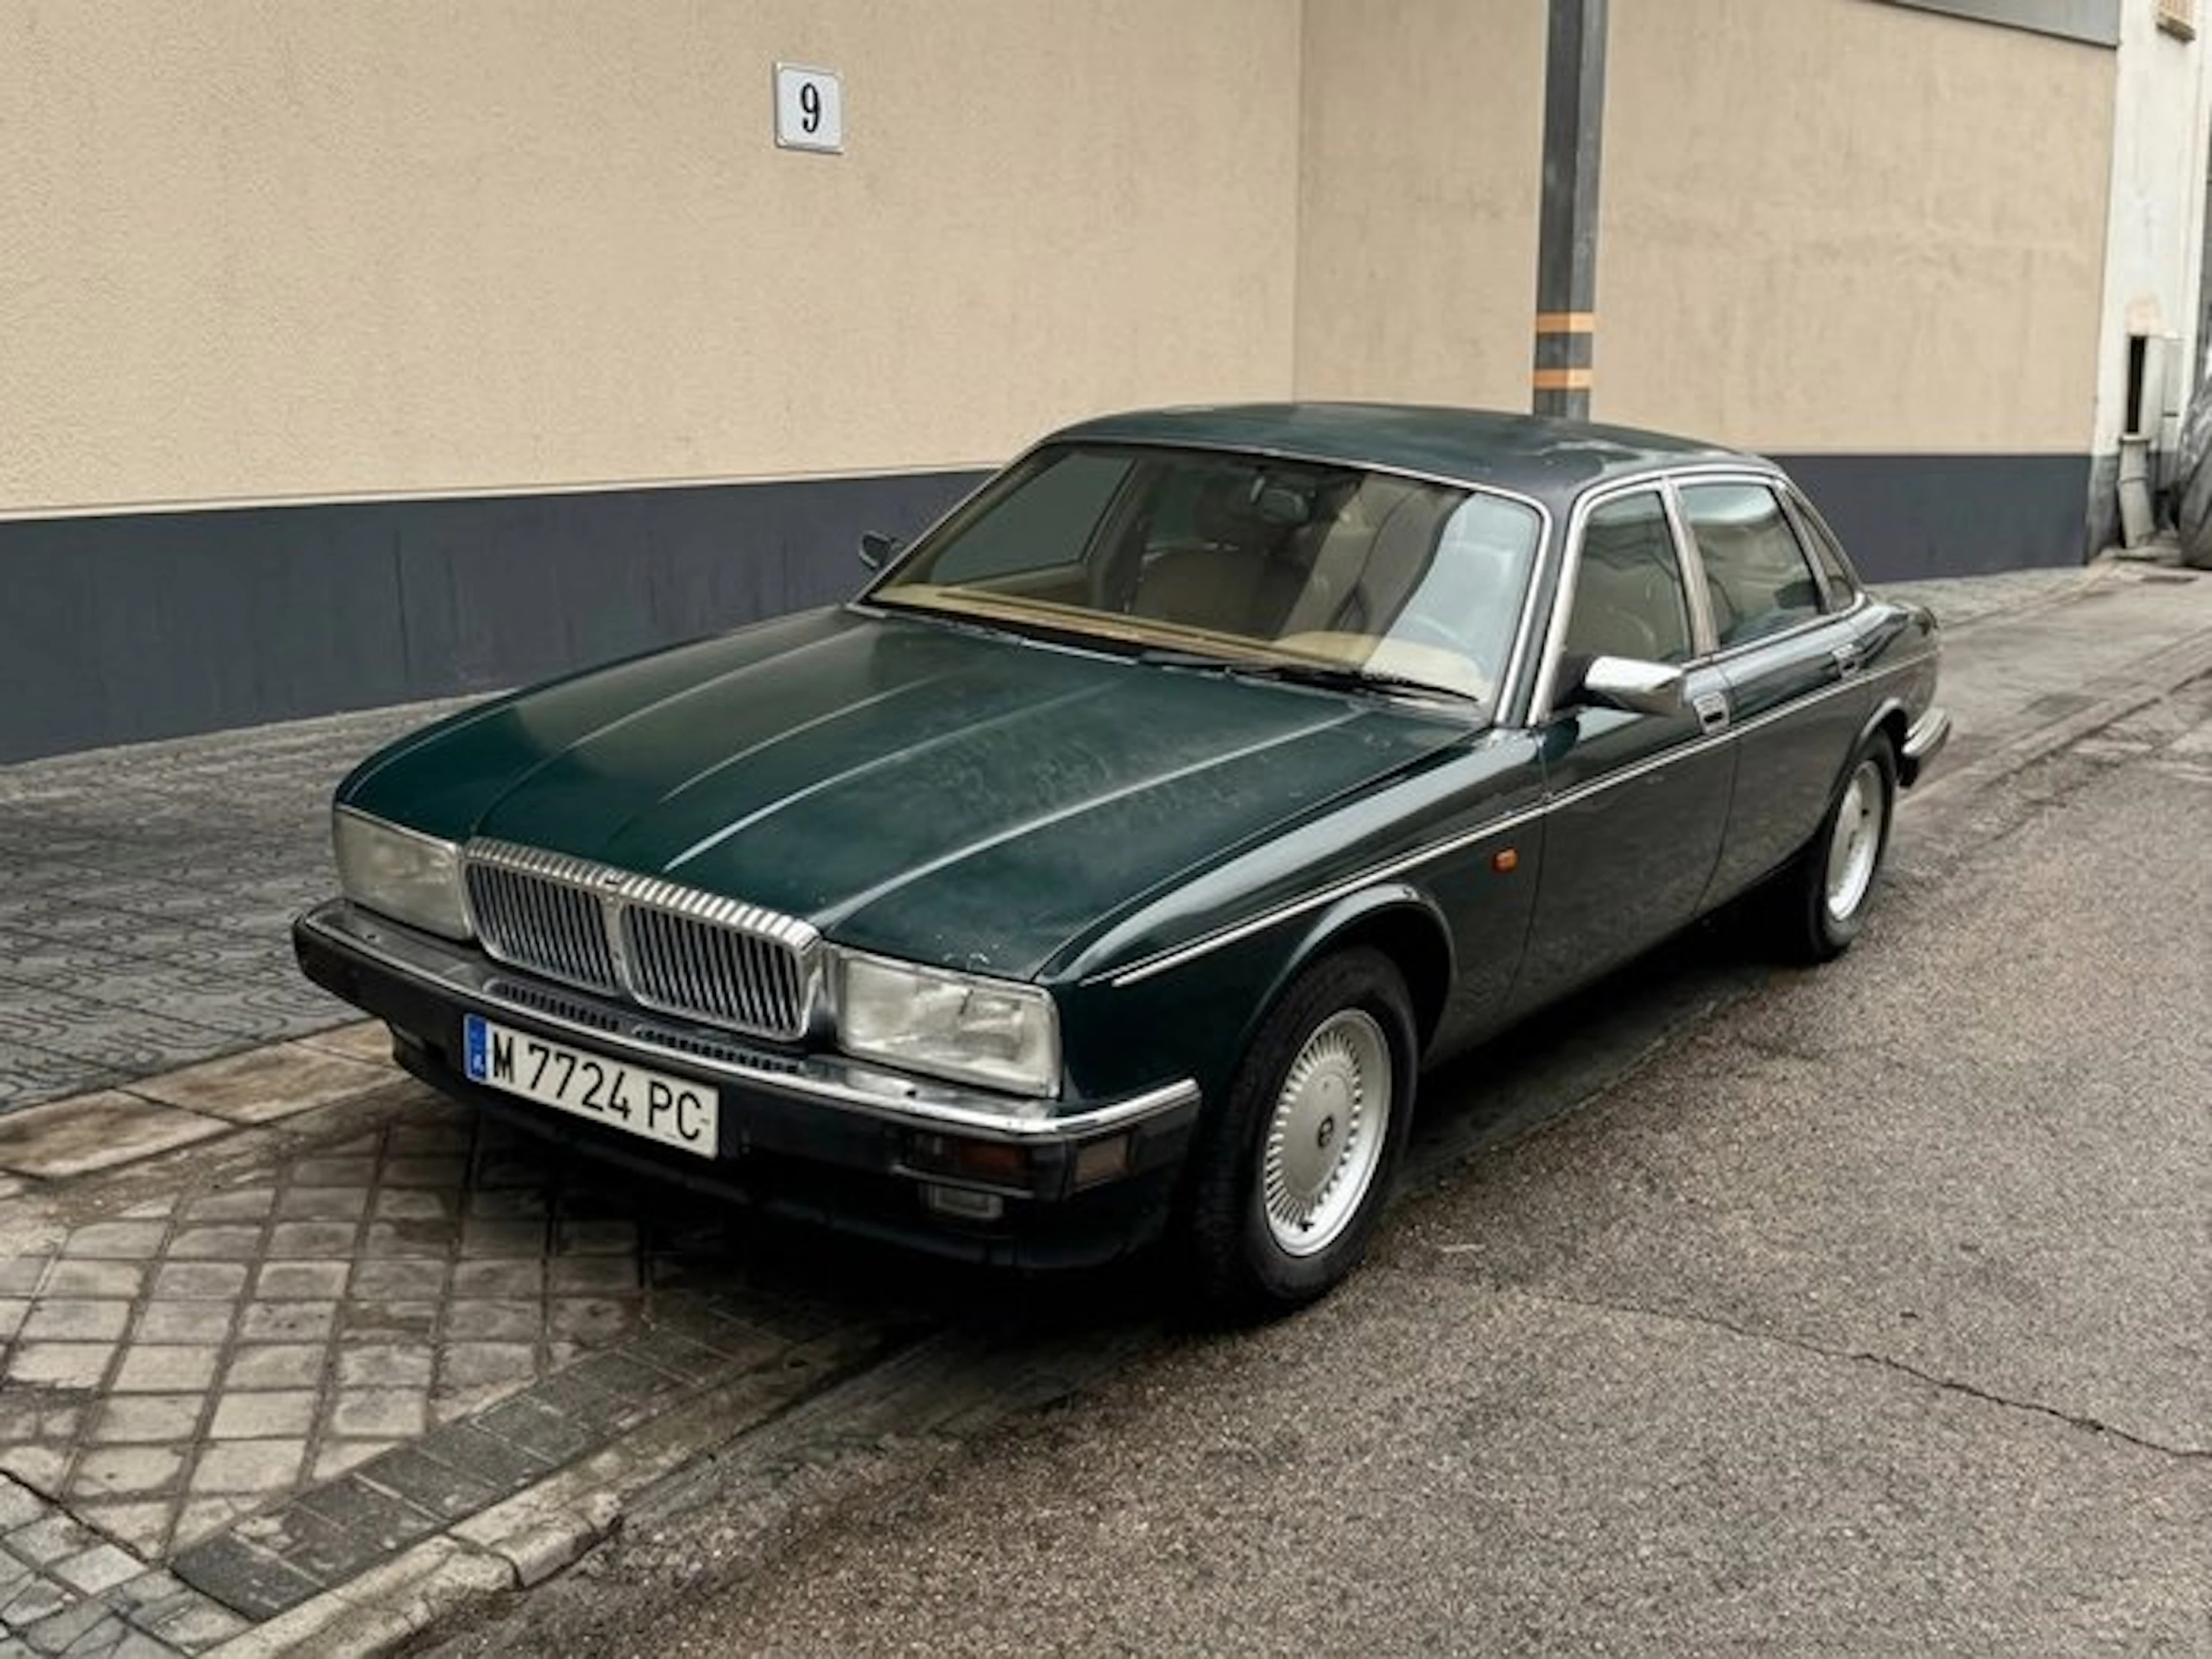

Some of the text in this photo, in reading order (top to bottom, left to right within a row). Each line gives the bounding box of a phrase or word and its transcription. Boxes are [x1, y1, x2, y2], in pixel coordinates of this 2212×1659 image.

[801, 82, 820, 133] 9
[494, 1034, 702, 1141] M 7724 PC
